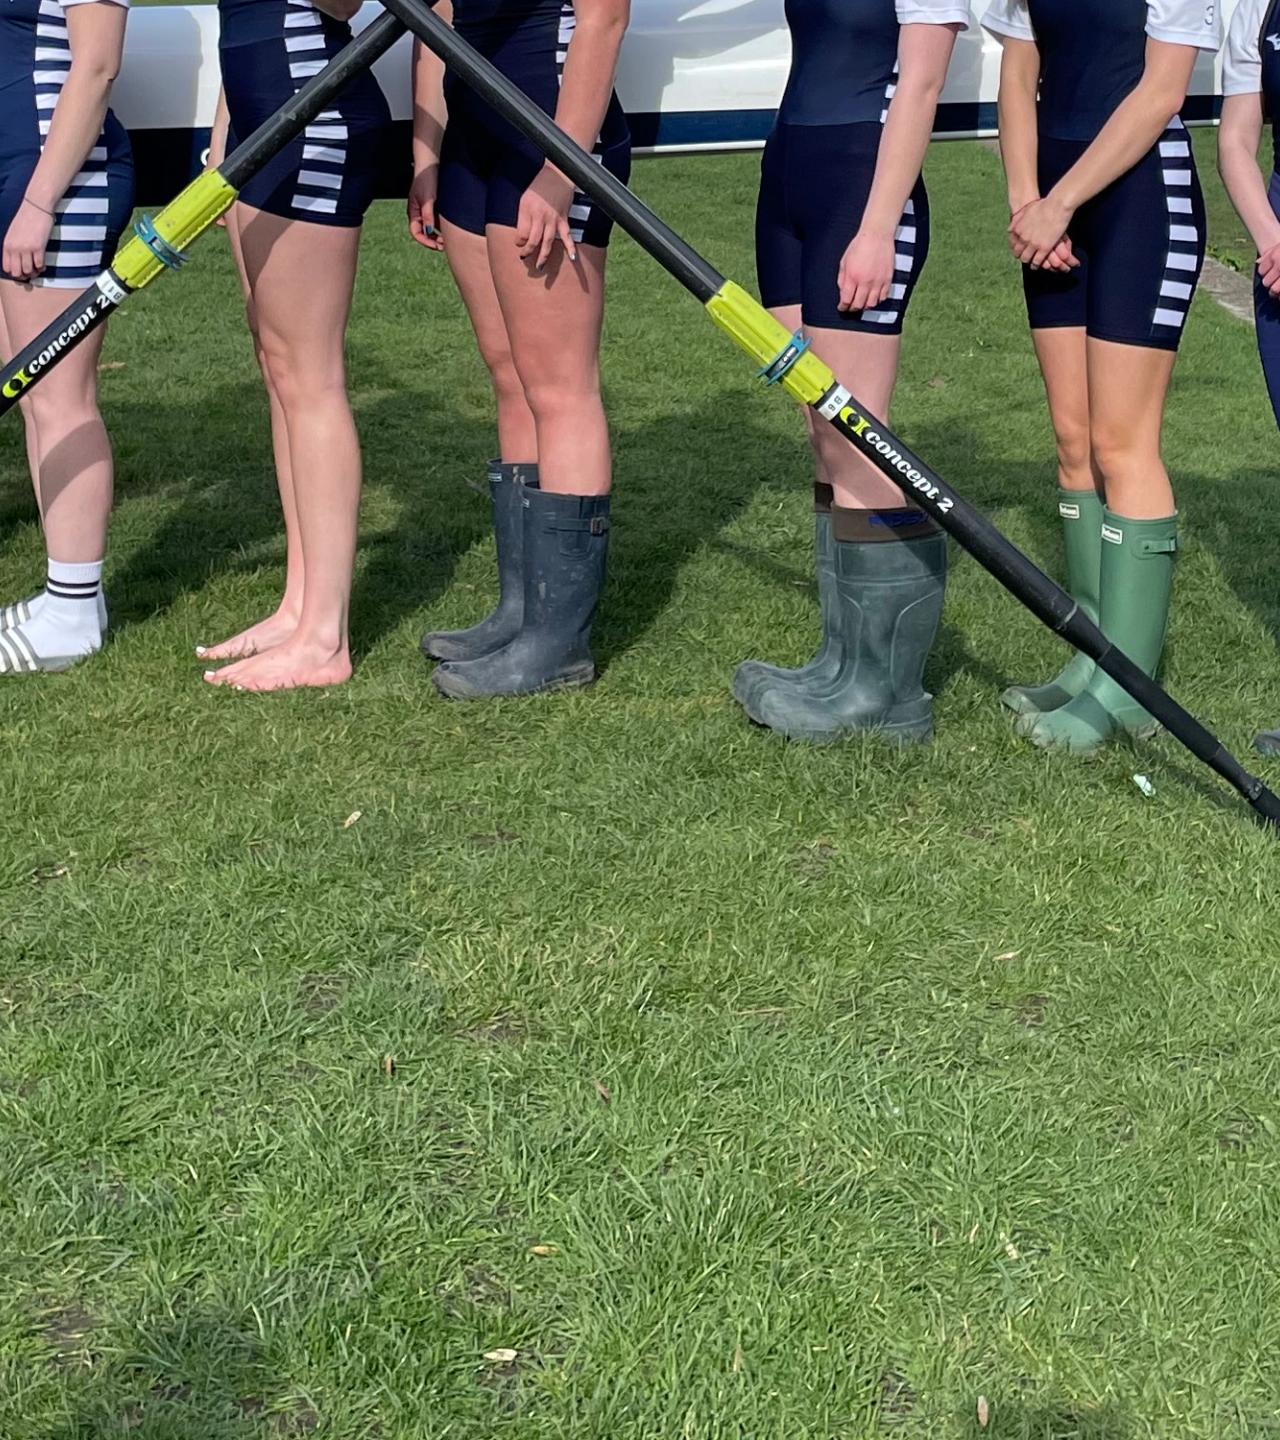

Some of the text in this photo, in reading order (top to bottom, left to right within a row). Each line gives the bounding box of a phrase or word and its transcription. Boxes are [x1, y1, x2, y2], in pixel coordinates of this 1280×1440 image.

[1204, 5, 1215, 26] 3
[28, 294, 111, 374] concept 2
[865, 431, 954, 513] concept 2
